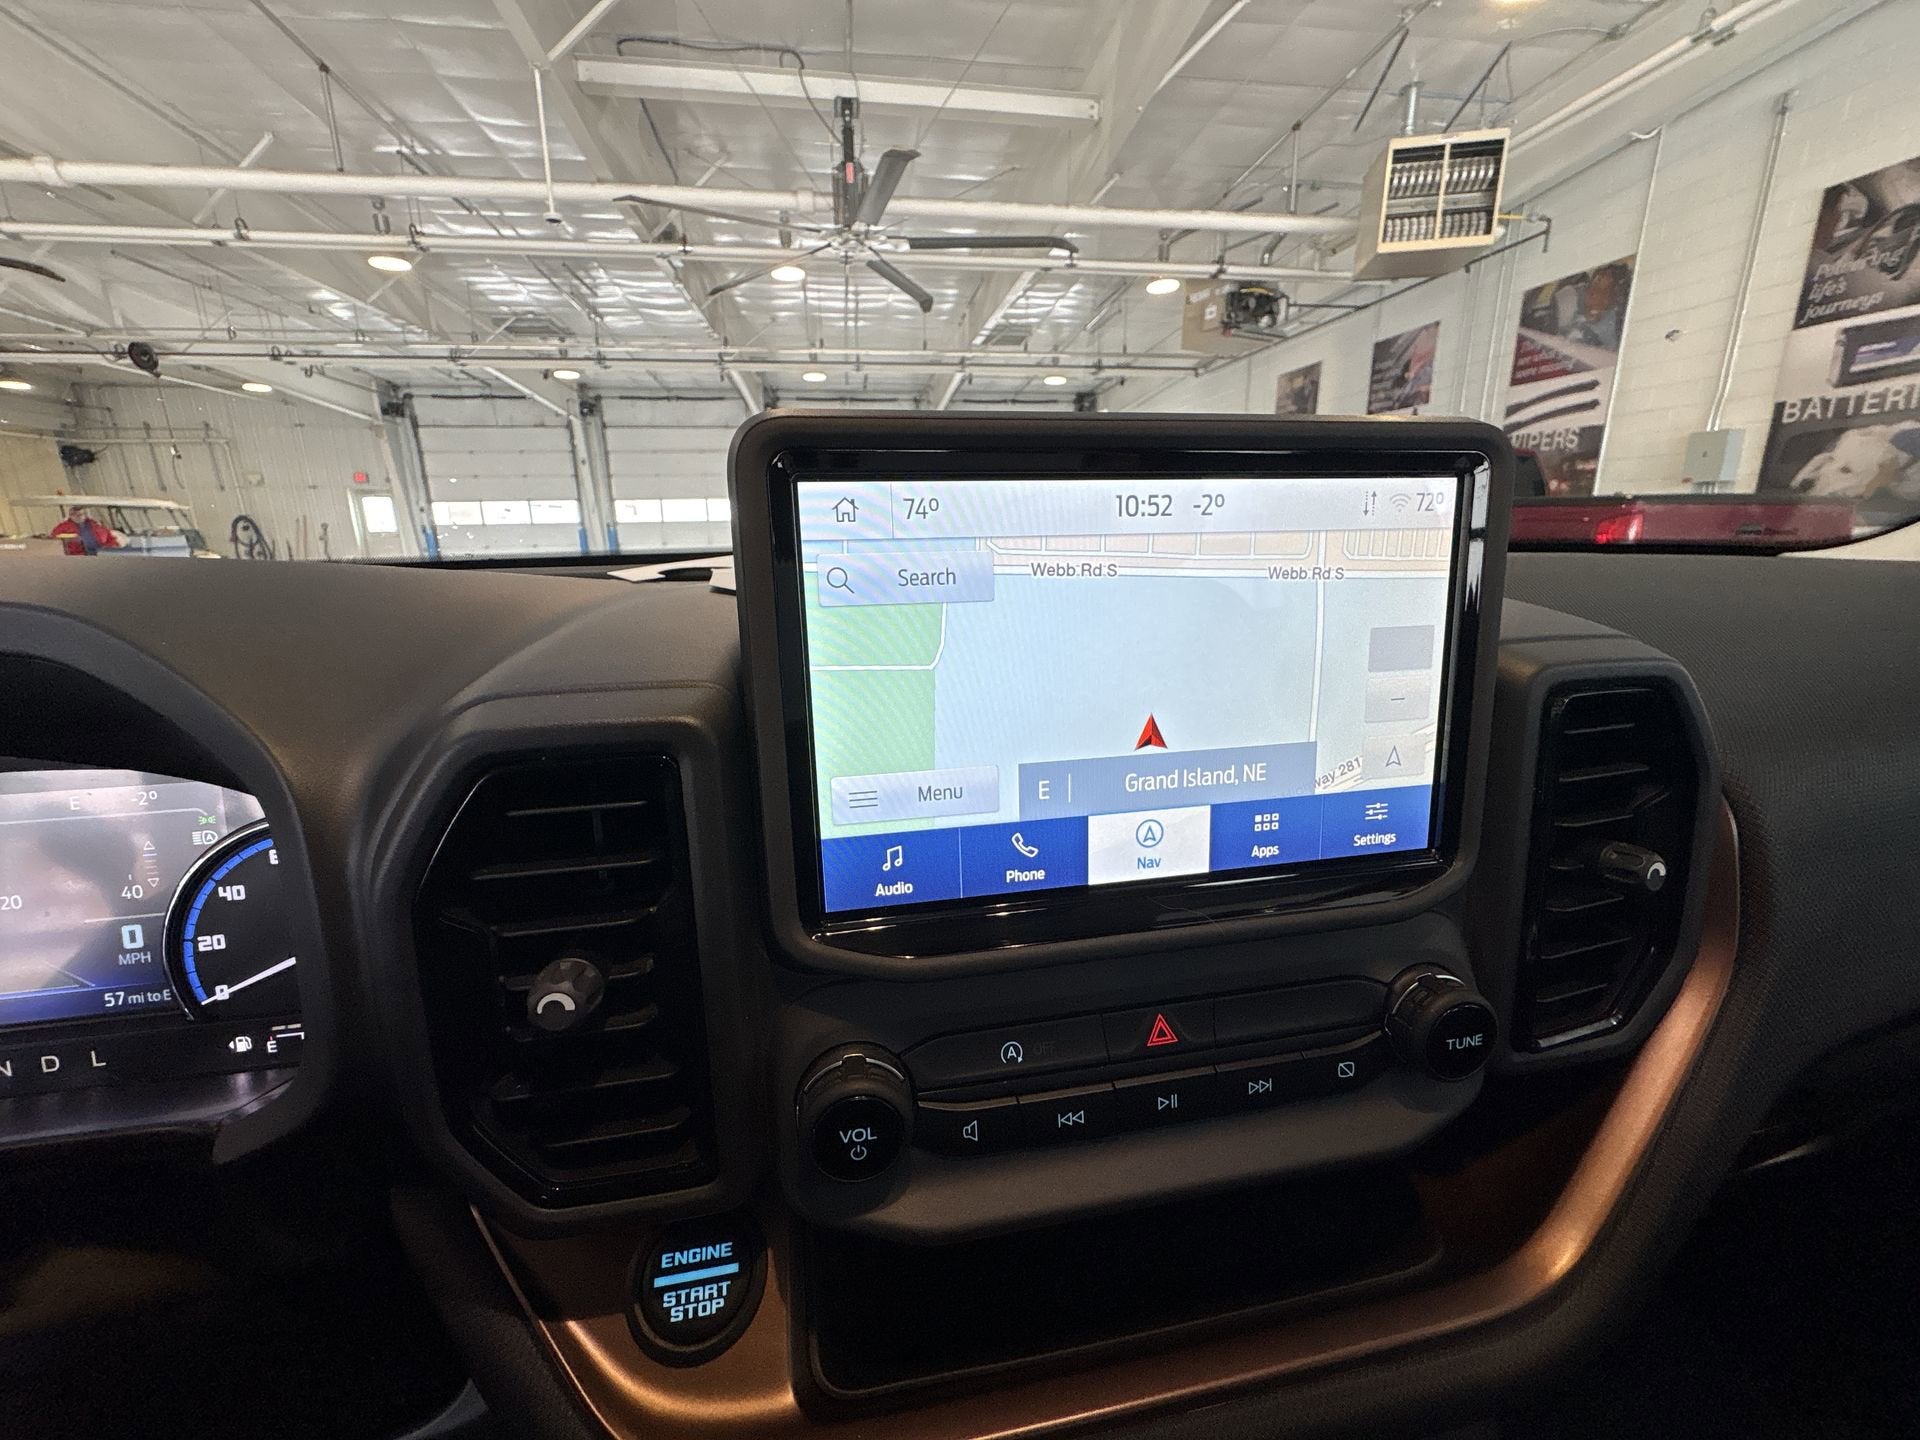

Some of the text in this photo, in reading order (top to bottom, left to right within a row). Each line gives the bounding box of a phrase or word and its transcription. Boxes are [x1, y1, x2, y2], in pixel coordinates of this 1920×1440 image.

[1782, 384, 1920, 423] BATTERI
[1115, 494, 1173, 517] 10:52
[898, 567, 957, 587] Search
[1031, 562, 1118, 577] Webb Rd S
[1268, 566, 1345, 580] Webb Rd S
[1339, 757, 1361, 777] 281
[1125, 762, 1267, 792] Grand Island, NE
[917, 785, 963, 803] Menu
[1038, 780, 1050, 800] E
[69, 796, 81, 811] E
[1353, 832, 1396, 847] Settings
[1251, 845, 1280, 859] Apps
[1137, 856, 1162, 870] Nav
[1006, 869, 1046, 883] Phone
[121, 884, 144, 900] 40
[218, 884, 246, 901] 40
[875, 881, 913, 897] Audio
[121, 924, 145, 950] 0
[198, 934, 226, 951] 20
[118, 952, 151, 966] MPH
[104, 989, 173, 1007] 57 mi to E
[266, 1040, 278, 1053] E
[1446, 1033, 1483, 1050] TUNE
[41, 1055, 60, 1073] D
[90, 1050, 107, 1067] L
[839, 1127, 878, 1143] VOL
[661, 1242, 733, 1269] ENGINE
[662, 1281, 731, 1308] START
[670, 1298, 725, 1323] STOP
